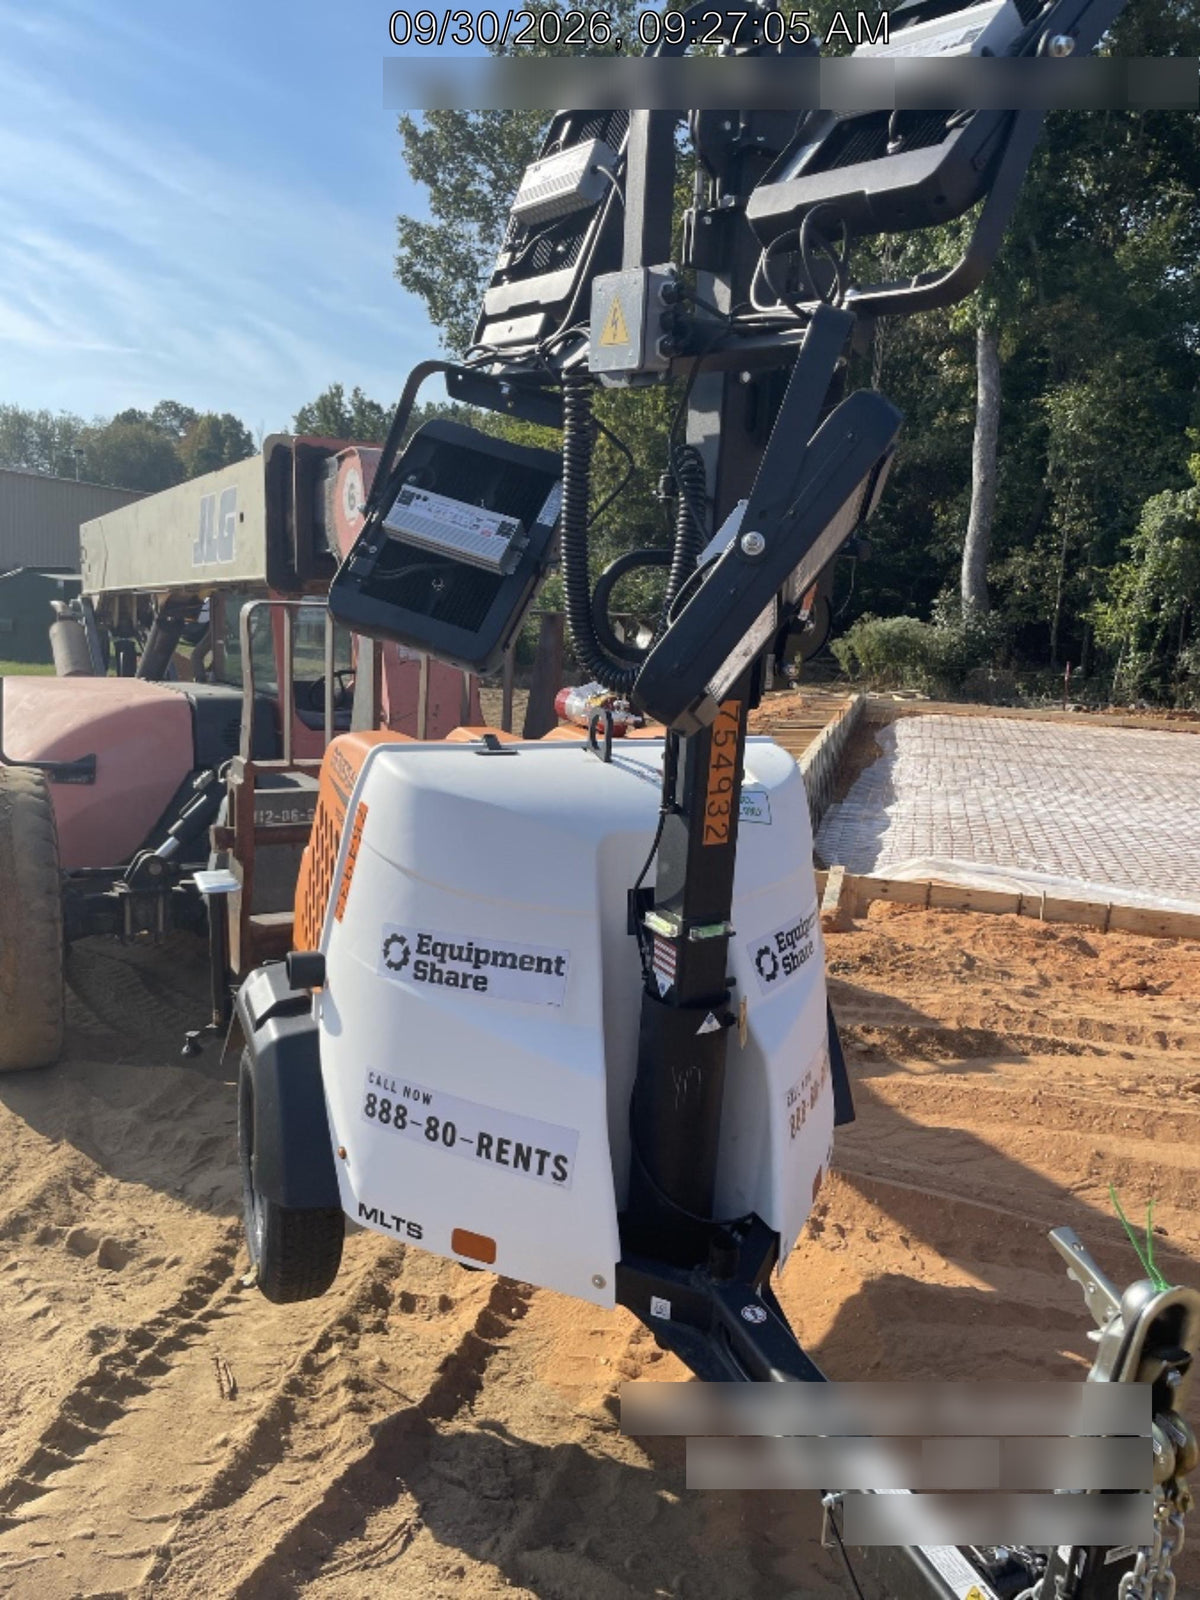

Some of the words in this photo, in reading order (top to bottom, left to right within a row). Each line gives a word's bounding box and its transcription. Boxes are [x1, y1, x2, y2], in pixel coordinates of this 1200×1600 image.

[192, 485, 238, 567] JLG
[705, 703, 740, 842] 754932
[412, 959, 489, 993] Share
[414, 933, 567, 977] Equipment
[781, 940, 815, 977] Share
[368, 1071, 398, 1094] CALL
[402, 1085, 433, 1106] NOW
[363, 1092, 569, 1183] 888-80-RENTS
[357, 1201, 424, 1241] MLTS
